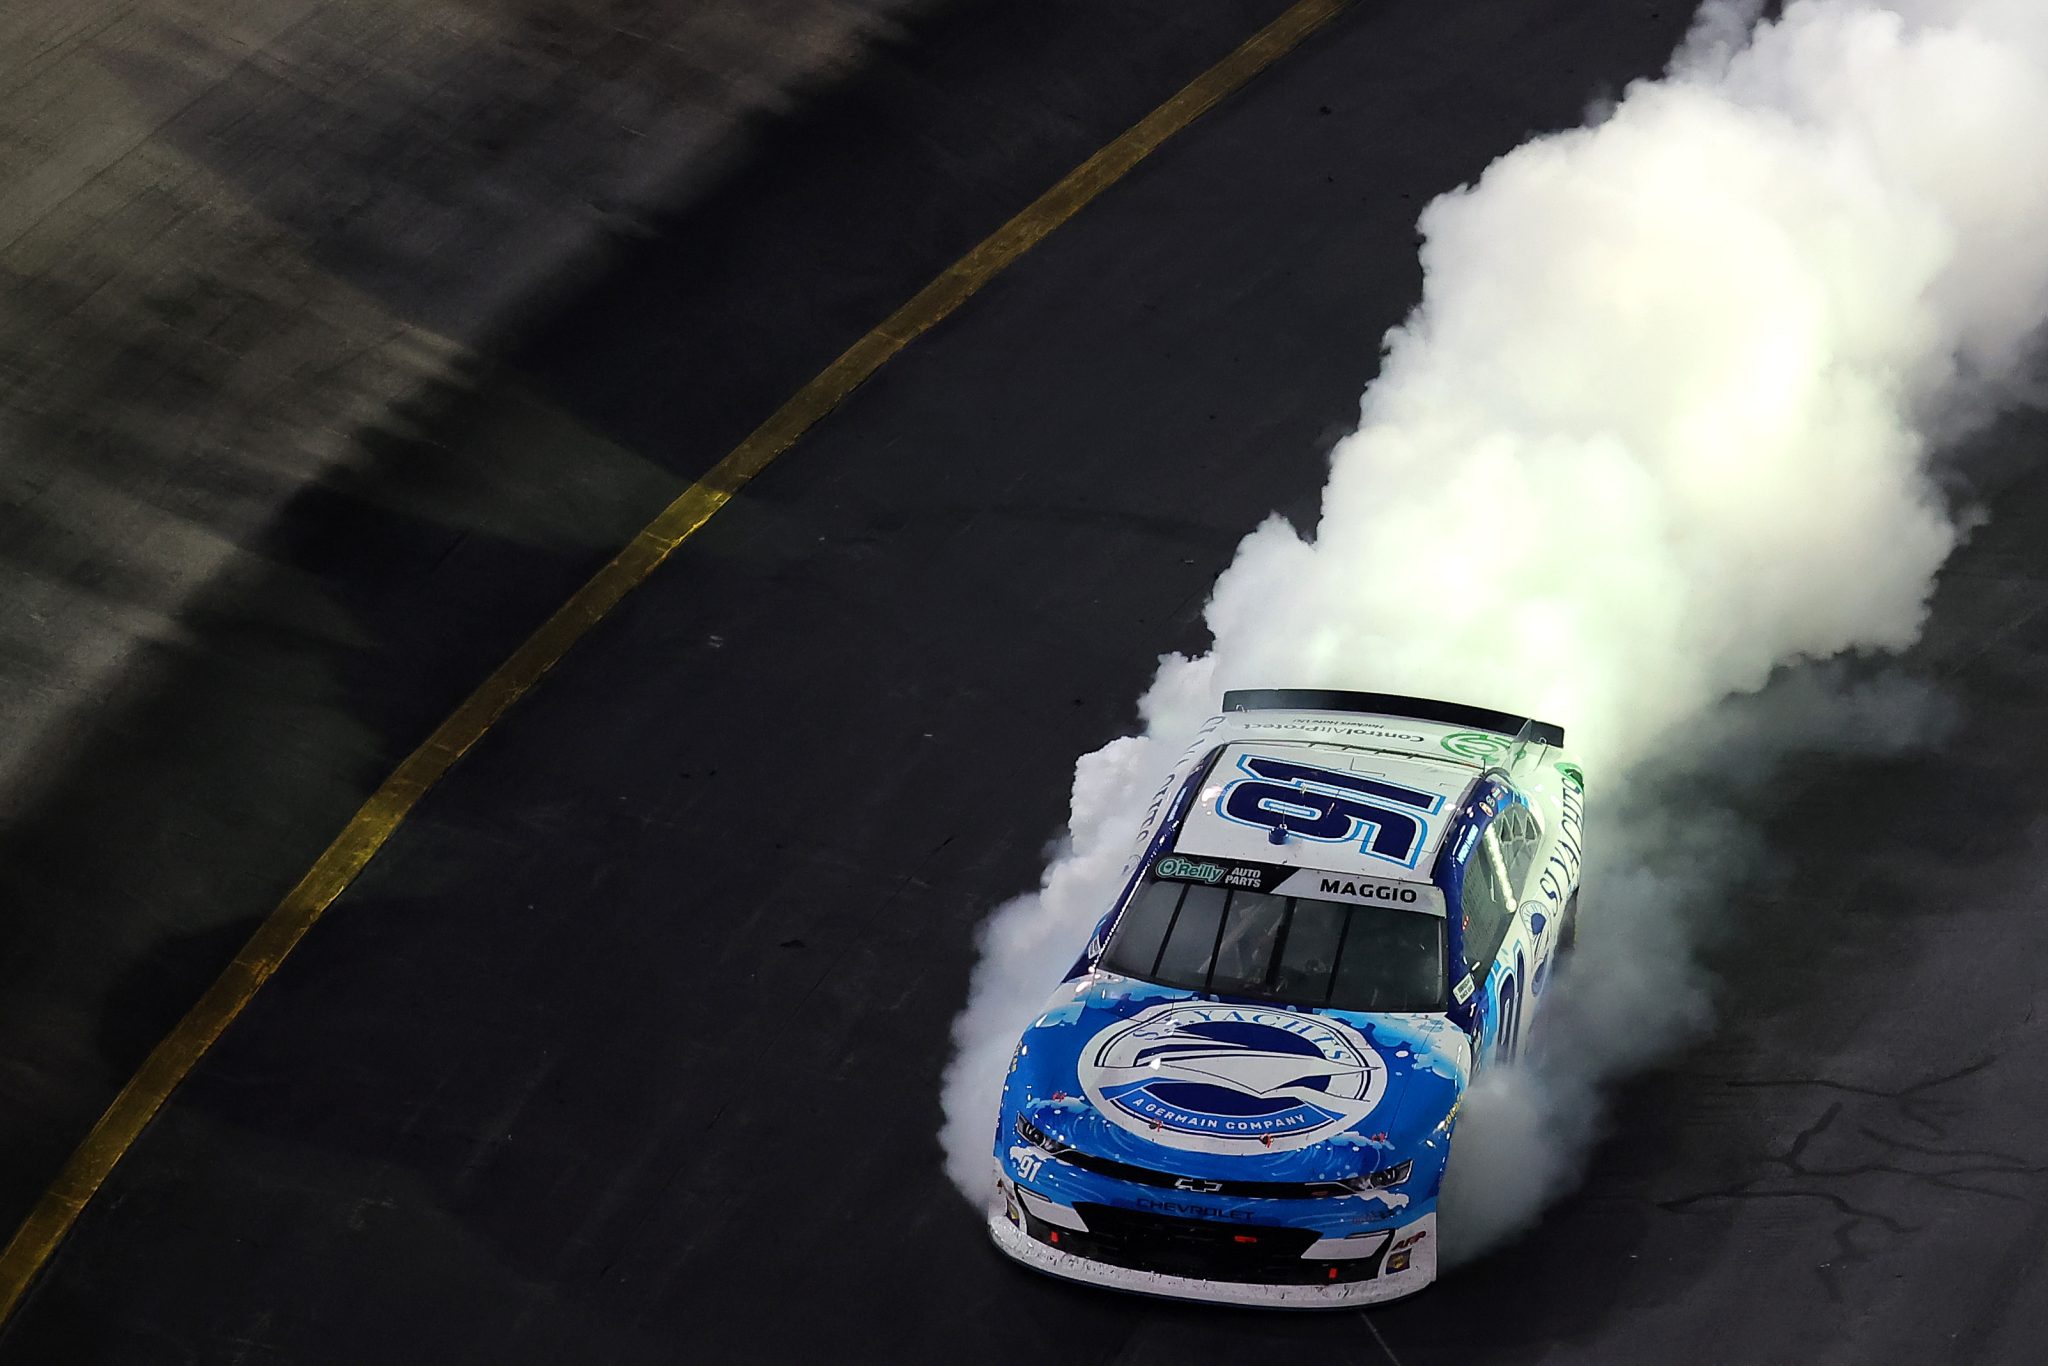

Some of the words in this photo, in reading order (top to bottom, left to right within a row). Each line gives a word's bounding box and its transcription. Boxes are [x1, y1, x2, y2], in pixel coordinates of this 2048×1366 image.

[1244, 723, 1425, 743] ControlAltProtect
[1216, 754, 1445, 870] 91
[1157, 859, 1227, 882] O'Reilly
[1225, 875, 1262, 888] PARTS
[1231, 867, 1261, 878] AUTO
[1320, 878, 1417, 903] MAGGIO
[1132, 1098, 1145, 1107] A
[1145, 1103, 1219, 1128] GERMAIN
[1225, 1114, 1306, 1130] COMPANY
[1017, 1155, 1042, 1183] 91
[1136, 1198, 1255, 1220] CHEVROLET
